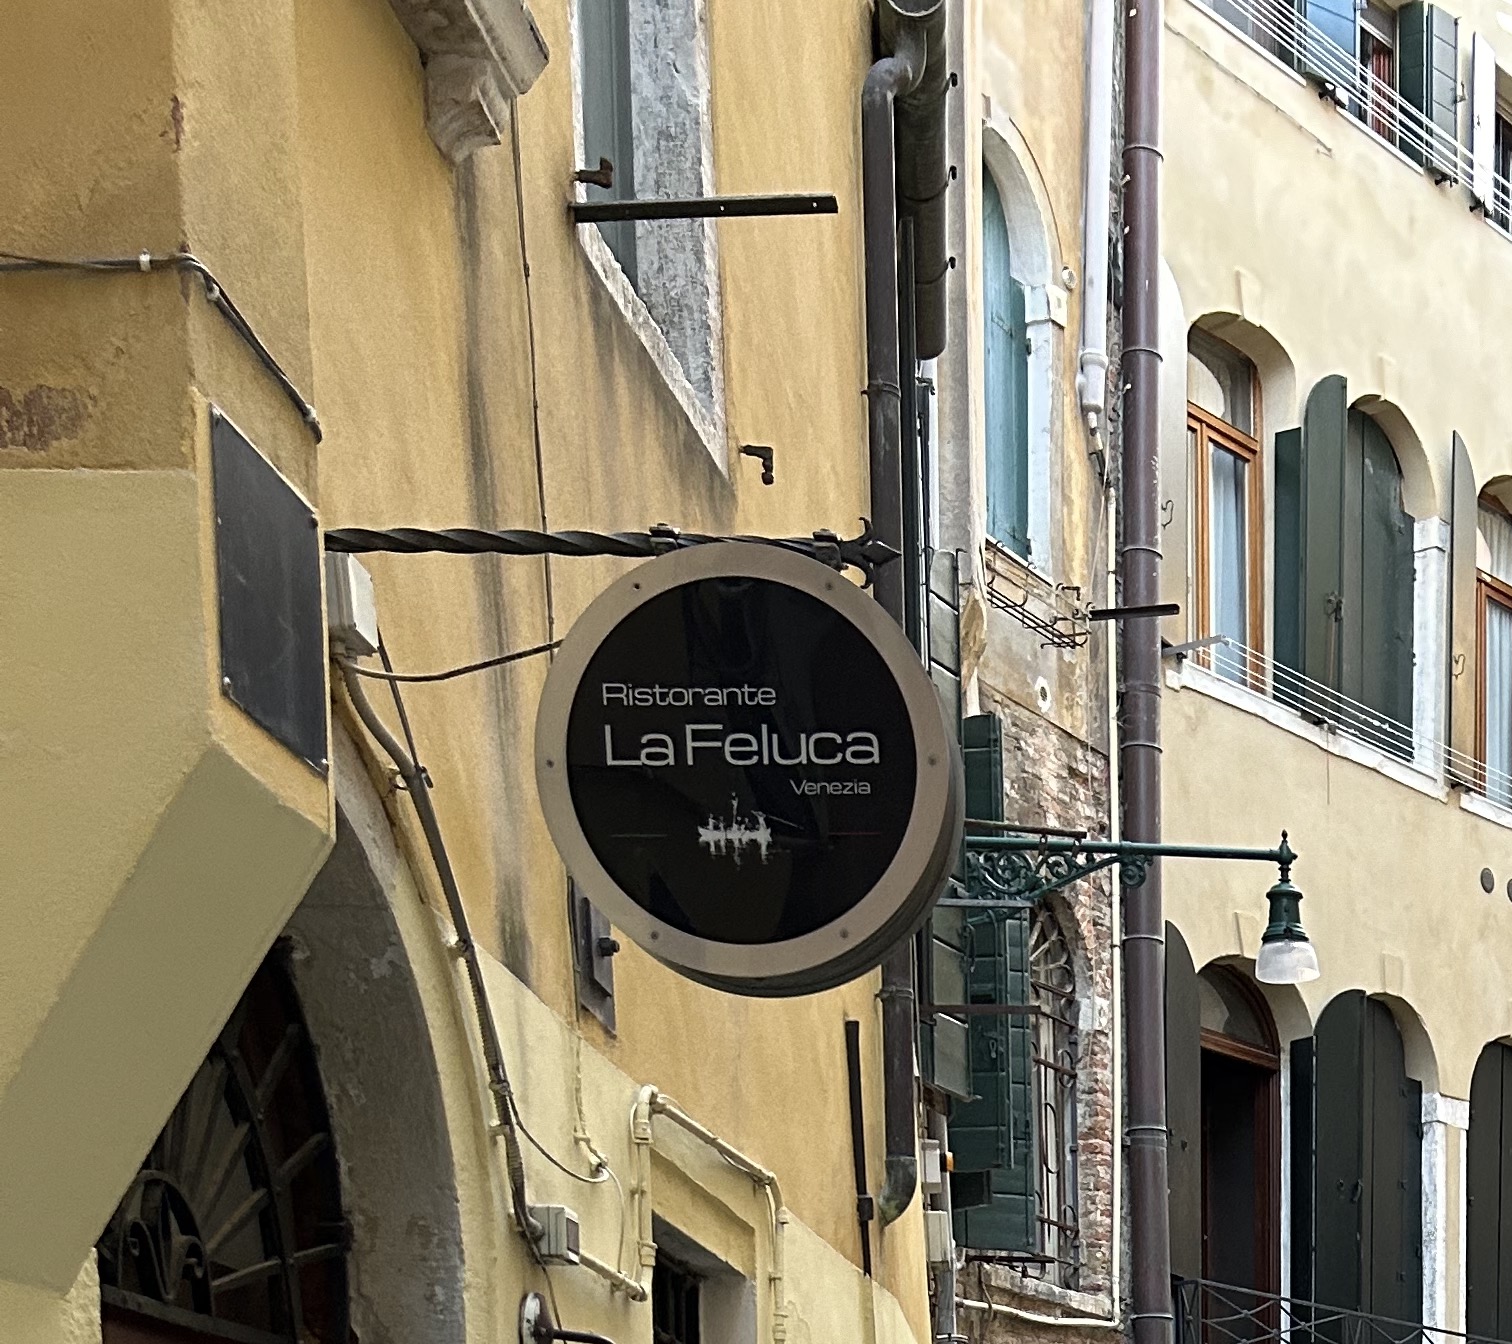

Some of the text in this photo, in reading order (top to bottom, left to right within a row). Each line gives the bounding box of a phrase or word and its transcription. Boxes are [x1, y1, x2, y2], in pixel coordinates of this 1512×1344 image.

[602, 683, 776, 706] Ristorante
[604, 723, 880, 766] La Feluca
[789, 778, 871, 796] Venezia
